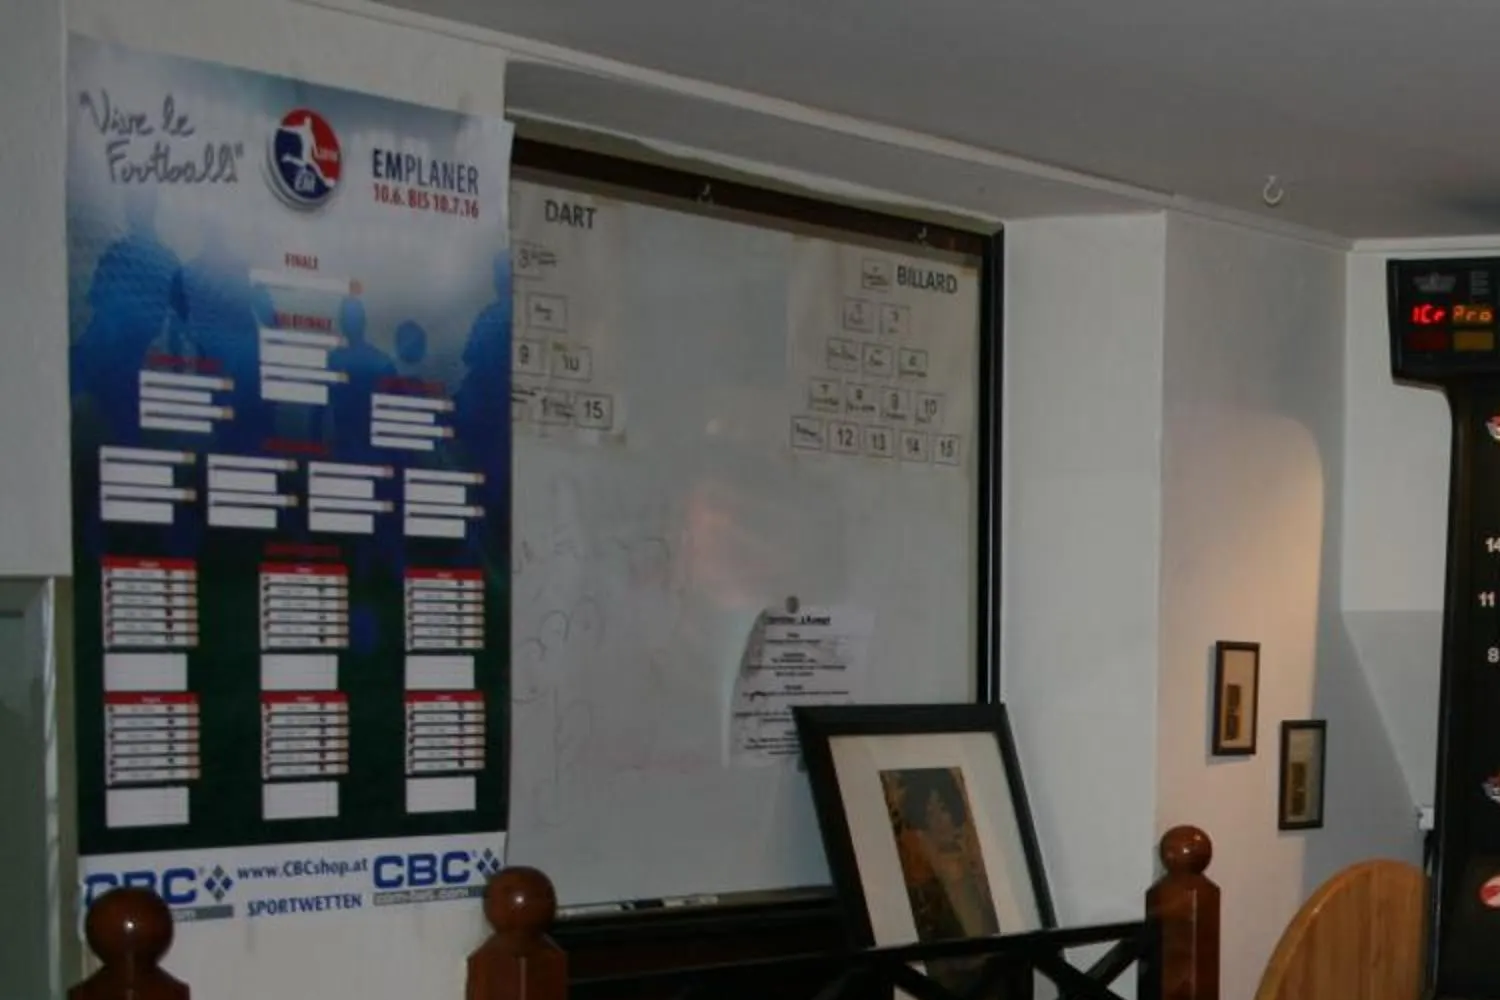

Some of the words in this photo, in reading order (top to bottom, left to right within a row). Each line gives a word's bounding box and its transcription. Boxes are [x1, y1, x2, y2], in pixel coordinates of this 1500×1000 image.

[161, 92, 196, 137] le
[372, 148, 479, 195] EMPLANER
[408, 188, 430, 210] BIS
[432, 193, 480, 219] 10.7.16
[543, 198, 597, 230] DART
[896, 264, 959, 295] BILLARD
[583, 400, 605, 420] 15
[836, 427, 854, 447] 12
[1479, 591, 1495, 607] 11
[1487, 647, 1500, 663] 8
[237, 857, 369, 879] www.CBCshop.at
[373, 851, 471, 889] CBC
[247, 893, 363, 918] SPORTWETTEN
